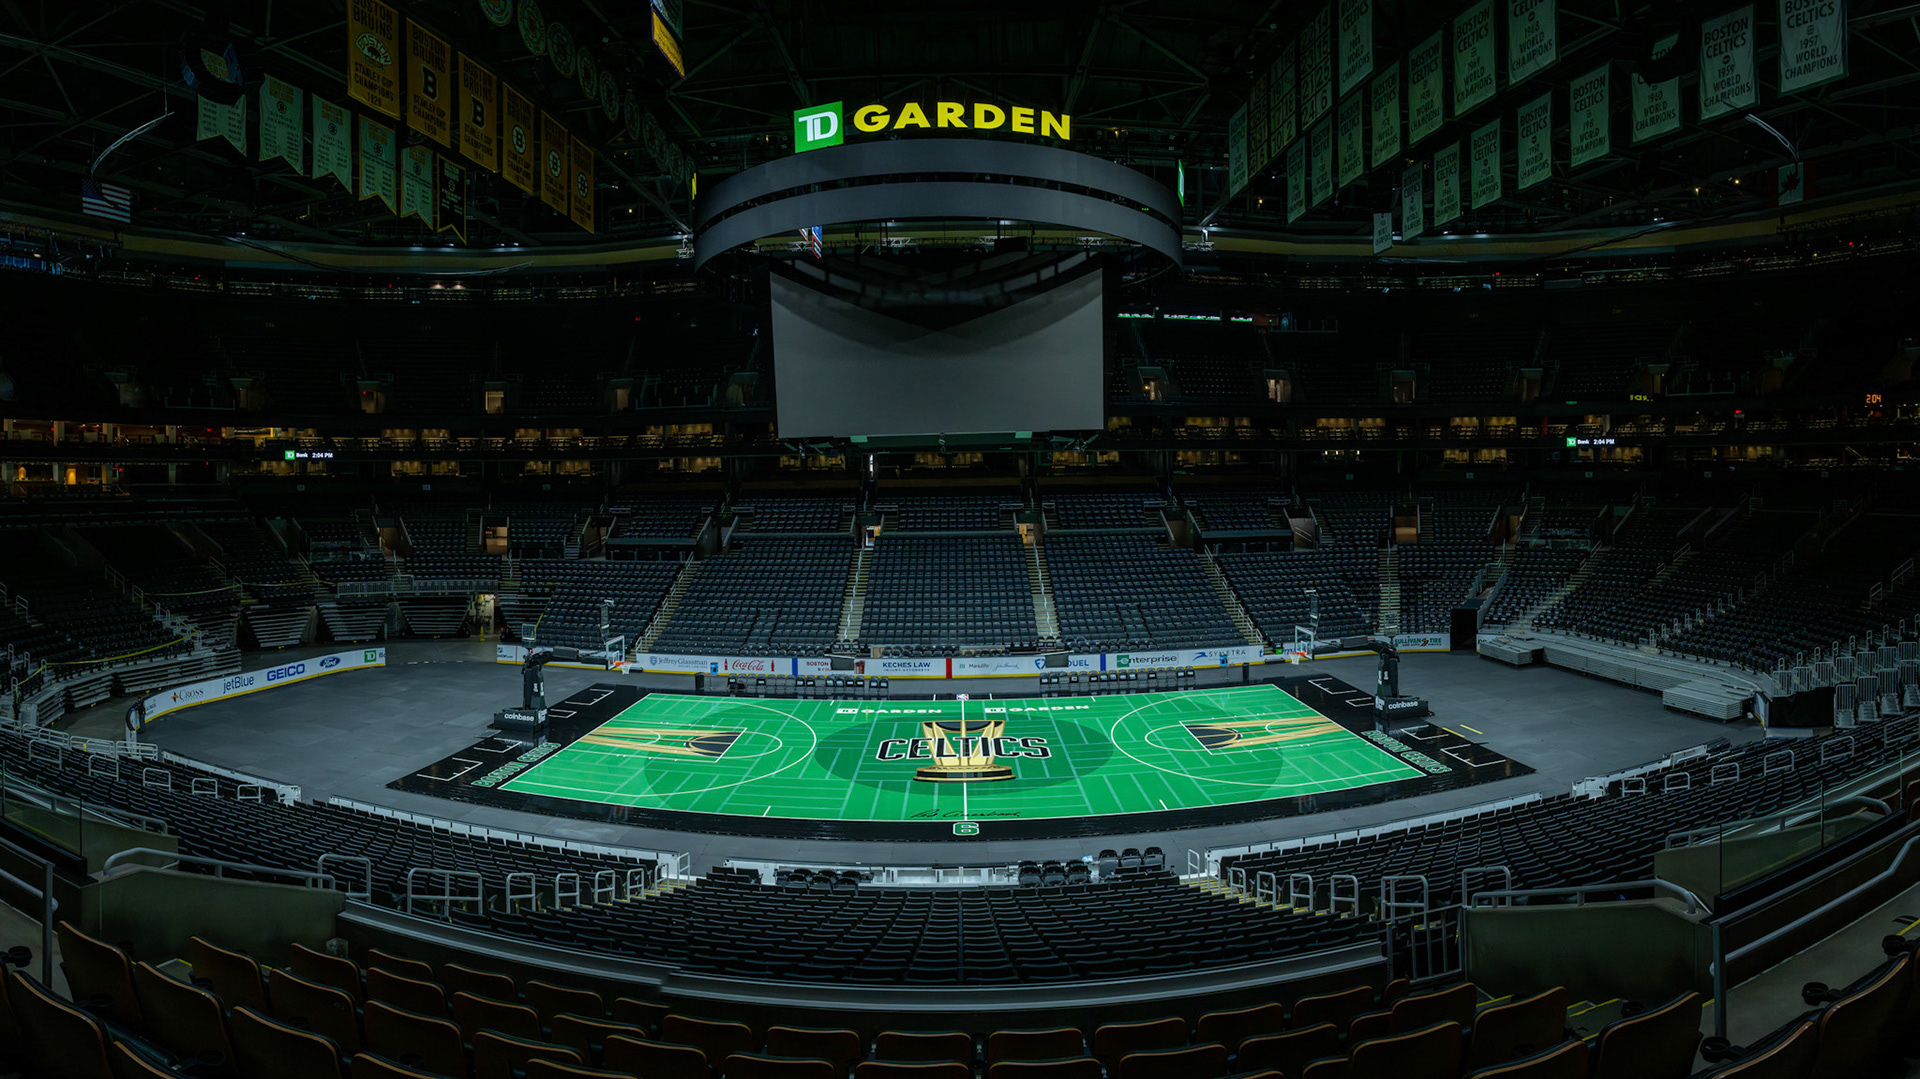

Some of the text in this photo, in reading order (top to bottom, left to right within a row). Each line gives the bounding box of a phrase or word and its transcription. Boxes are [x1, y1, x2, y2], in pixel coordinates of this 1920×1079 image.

[353, 0, 392, 24] OSTON
[353, 5, 392, 41] BRUINS
[1342, 0, 1369, 32] CELTICS
[1457, 6, 1490, 39] BOSTON
[1787, 1, 1835, 29] CELTICS
[412, 24, 446, 58] BOSTON
[1457, 22, 1489, 53] CELTICS
[1519, 31, 1545, 54] WORLD
[1704, 17, 1749, 46] BOSTON
[1799, 36, 1819, 50] 1957
[412, 40, 446, 73] BRUINS
[1411, 41, 1440, 72] BOSTON
[1512, 38, 1553, 71] CHAMPIONS
[1705, 32, 1747, 58] CELTICS
[1795, 45, 1828, 65] WORLD
[355, 62, 380, 82] STANLEY
[463, 57, 492, 87] BOSTON
[1316, 64, 1330, 89] 25
[1412, 56, 1439, 85] CELTICS
[1463, 66, 1485, 87] WORLD
[1718, 64, 1735, 79] 1959
[1784, 54, 1838, 81] CHAMPIONS
[354, 73, 394, 101] CHAMPIONS
[463, 72, 493, 103] BRUINS
[1302, 71, 1314, 102] 21
[1374, 71, 1397, 99] BOSTON
[1456, 74, 1492, 103] CHAMPIONS
[1573, 75, 1606, 101] BOSTON
[1713, 74, 1741, 92] WORLD
[1322, 89, 1328, 110] 6
[1374, 87, 1396, 112] CELTICS
[1574, 89, 1604, 112] CELTICS
[1703, 82, 1751, 108] CHAMPIONS
[1520, 103, 1549, 127] BOSTON
[1635, 108, 1677, 131] CHAMPIONS
[1644, 101, 1668, 117] WORLD
[798, 101, 1071, 142] TD GARDEN
[1286, 121, 1292, 140] 2
[1521, 117, 1547, 139] CELTICS
[1473, 127, 1498, 150] BOSTON
[1573, 135, 1606, 156] CHAMPIONS
[1579, 127, 1600, 143] WORLD
[1435, 151, 1457, 171] BOSTON
[1474, 141, 1497, 162] CELTICS
[1436, 163, 1458, 181] CELTICS
[1520, 159, 1550, 181] CHAMPIONS
[1394, 637, 1422, 647] SULLIVAN
[266, 664, 306, 681] GEICO
[320, 657, 341, 668] Ford
[223, 673, 255, 694] jetBlue
[504, 712, 535, 721] coinbase
[1008, 705, 1090, 713] GARDEN
[1388, 701, 1419, 710] coinbase
[875, 736, 1052, 761] CELTICS
[953, 821, 981, 837] 6
